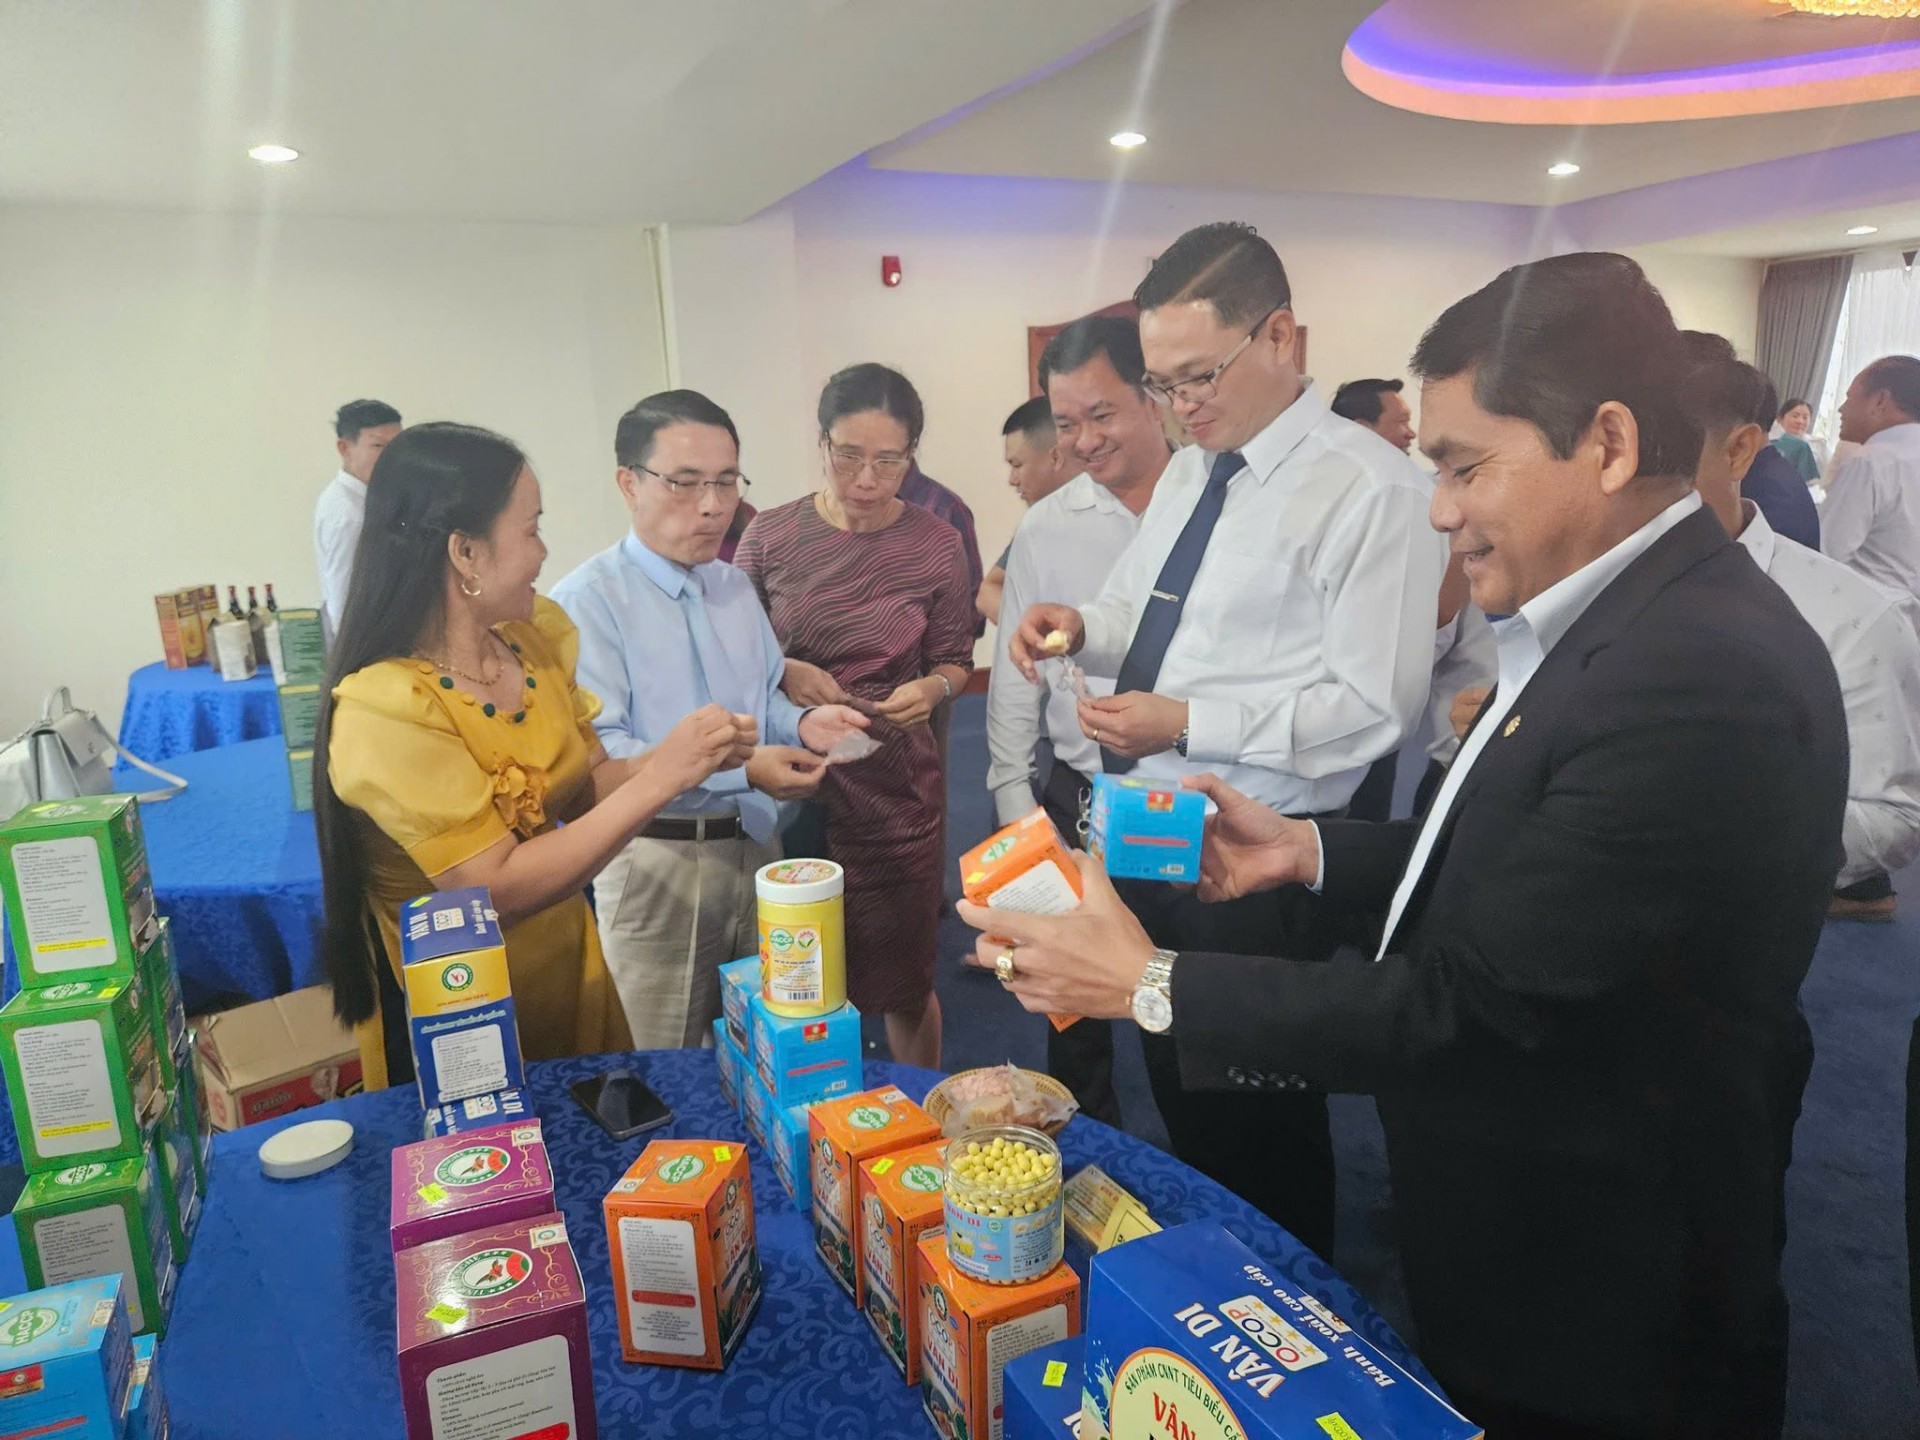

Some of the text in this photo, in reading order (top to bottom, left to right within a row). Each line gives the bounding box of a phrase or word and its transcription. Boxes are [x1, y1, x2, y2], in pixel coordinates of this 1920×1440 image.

[1243, 1264, 1273, 1287] cấp
[1273, 1288, 1304, 1312] cao
[15, 1310, 33, 1346] HACCP
[1173, 1302, 1223, 1338] DI
[1228, 1308, 1300, 1363] OCOP
[1298, 1313, 1343, 1343] xoài
[1210, 1334, 1286, 1398] VÂN
[1343, 1345, 1396, 1387] Bánh
[1124, 1370, 1138, 1395] SẢN
[1158, 1363, 1179, 1383] CNNT
[1182, 1372, 1201, 1401] TIÊU
[1203, 1394, 1225, 1426] BIỂU
